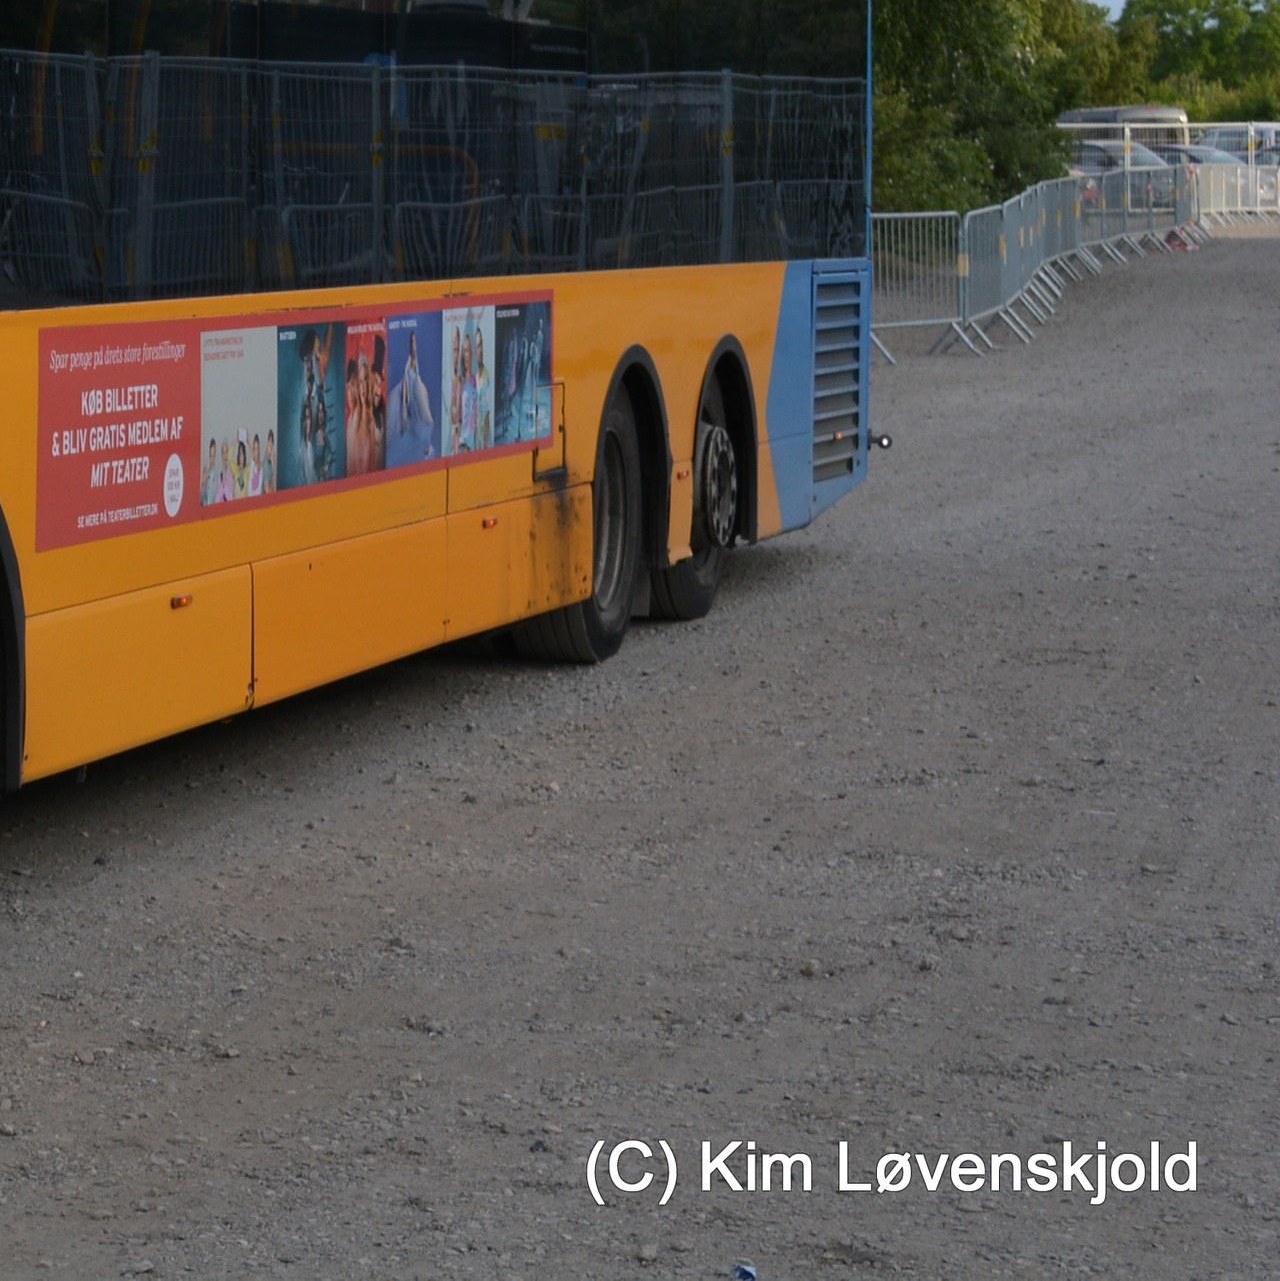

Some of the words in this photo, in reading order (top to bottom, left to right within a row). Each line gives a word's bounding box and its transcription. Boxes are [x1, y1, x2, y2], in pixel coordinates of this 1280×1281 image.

[49, 349, 69, 373] Spar
[69, 350, 92, 372] penge
[123, 345, 141, 364] store
[141, 340, 186, 365] forestillinger
[81, 388, 103, 417] KØB
[105, 383, 159, 413] BILLETTER
[51, 430, 61, 457] &
[62, 428, 87, 455] BLIV
[89, 423, 126, 452] GRATIS
[127, 417, 169, 447] MEDLEM
[170, 416, 184, 440] AF
[90, 462, 111, 488] MIT
[111, 455, 150, 484] TEATER
